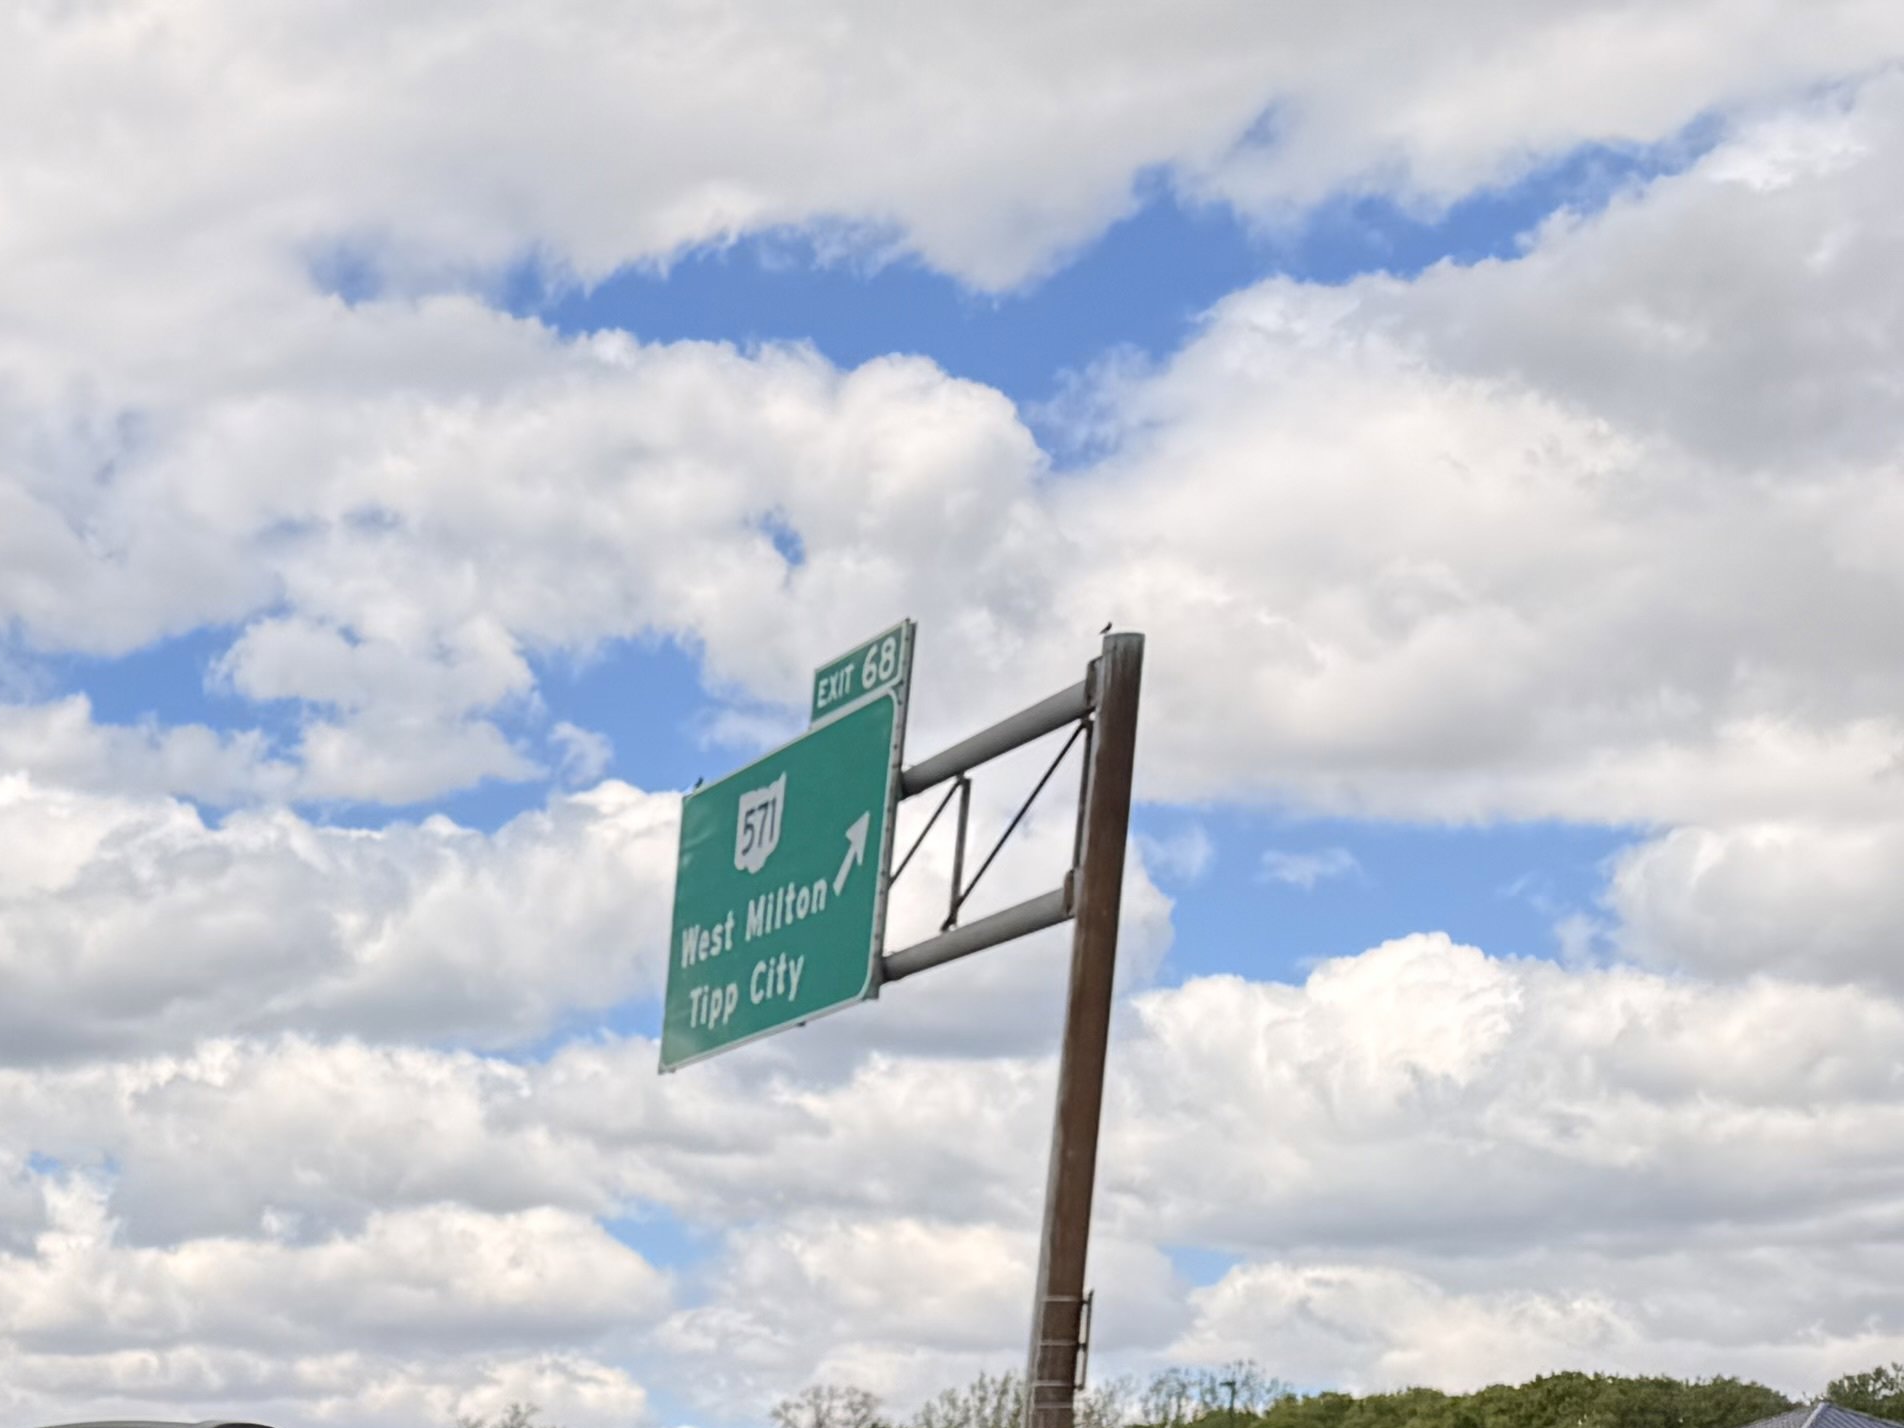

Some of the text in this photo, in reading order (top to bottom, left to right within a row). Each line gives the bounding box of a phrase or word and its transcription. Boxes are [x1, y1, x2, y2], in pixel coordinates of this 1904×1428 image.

[817, 636, 896, 708] EXIT 68
[742, 797, 777, 856] 571
[681, 877, 827, 969] West Milton
[690, 952, 805, 1030] Tipp City
